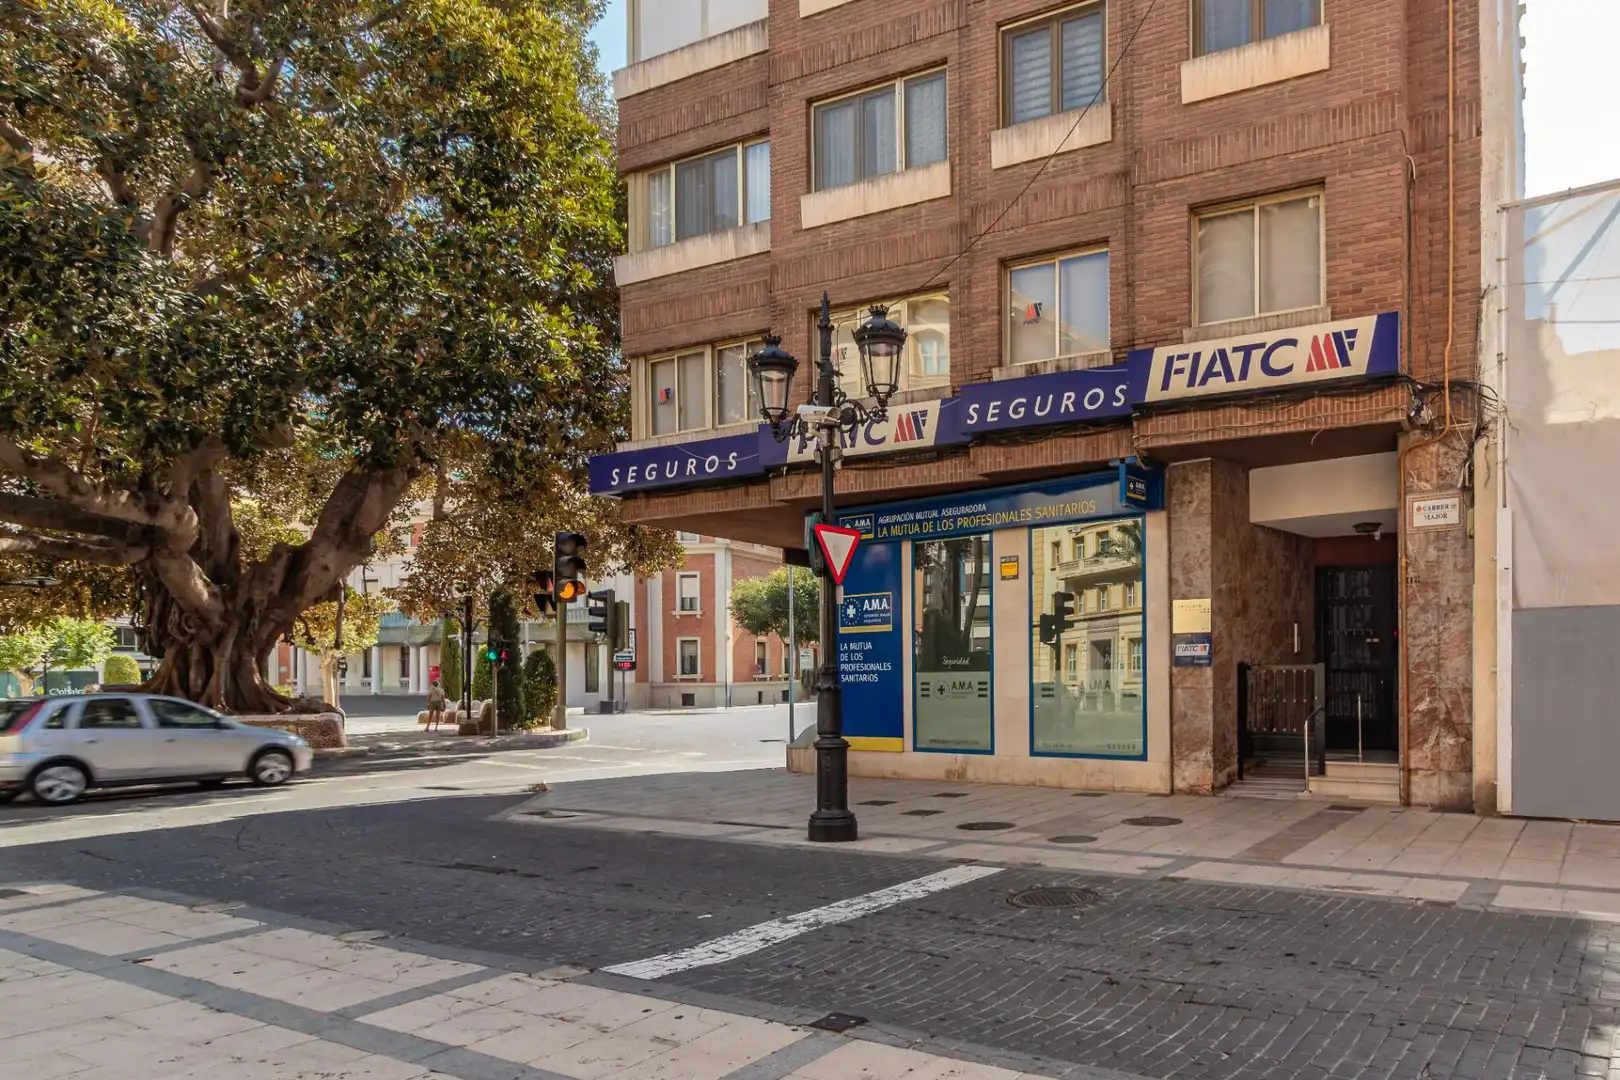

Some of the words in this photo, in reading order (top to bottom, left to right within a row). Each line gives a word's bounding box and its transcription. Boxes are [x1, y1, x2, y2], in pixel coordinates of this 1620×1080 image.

[1161, 338, 1299, 391] FIATC
[967, 384, 1128, 424] SEGUROS
[610, 452, 738, 486] SEGUROS
[878, 512, 914, 525] AGRUPACIÓN
[915, 509, 939, 519] MUTUAL
[941, 503, 987, 516] ASEGURADORA
[878, 527, 889, 538] LA
[891, 523, 920, 536] MUTUA
[922, 524, 934, 533] DE
[937, 519, 954, 532] LOS
[957, 508, 1033, 529] PROFESIONALES
[1035, 500, 1097, 520] SANITARIOS
[1424, 512, 1448, 520] MAJOR
[840, 643, 848, 651] LA
[849, 641, 873, 651] MUTUA
[840, 653, 849, 661] DE
[850, 652, 864, 661] LOS
[840, 662, 892, 672] PROFESIONALES
[840, 673, 879, 682] SANITARIOS
